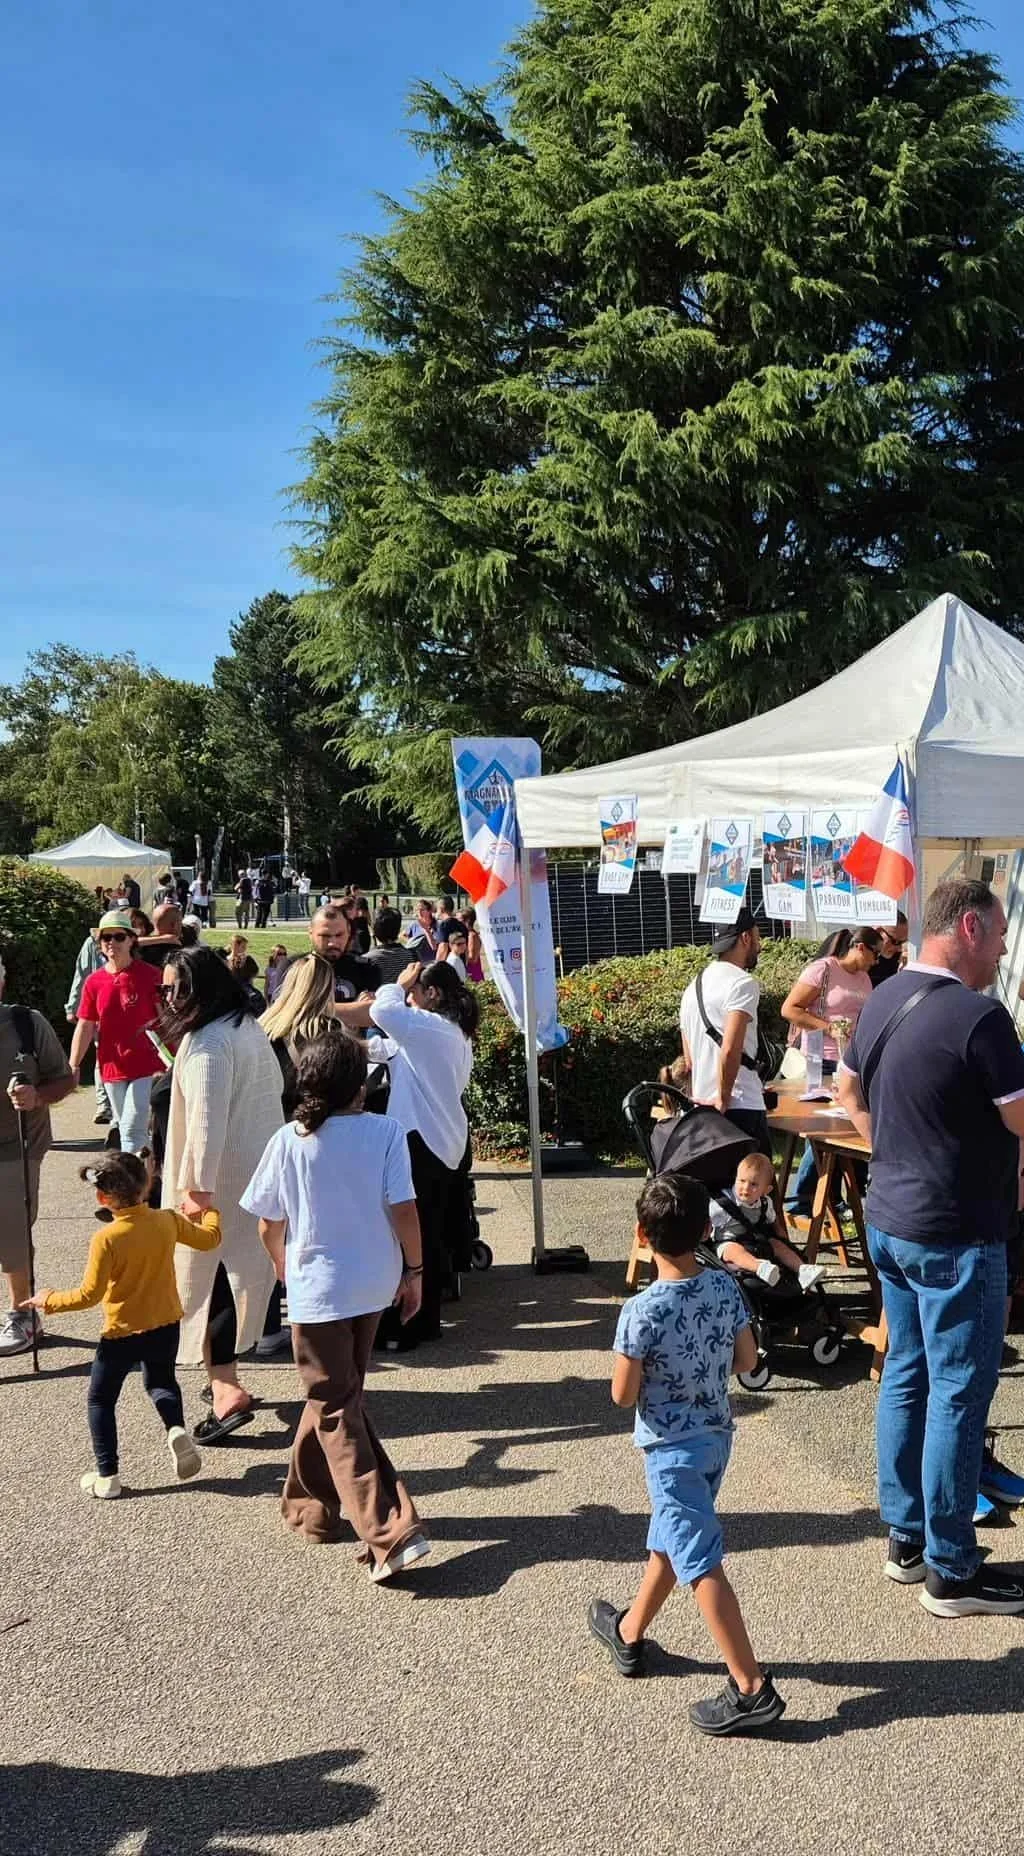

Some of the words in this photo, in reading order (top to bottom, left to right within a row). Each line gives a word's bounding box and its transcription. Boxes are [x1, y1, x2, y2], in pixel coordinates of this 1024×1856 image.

[711, 898, 736, 911] FITNESS
[819, 894, 851, 907] PARKOUR
[859, 899, 892, 912] TUMBLING
